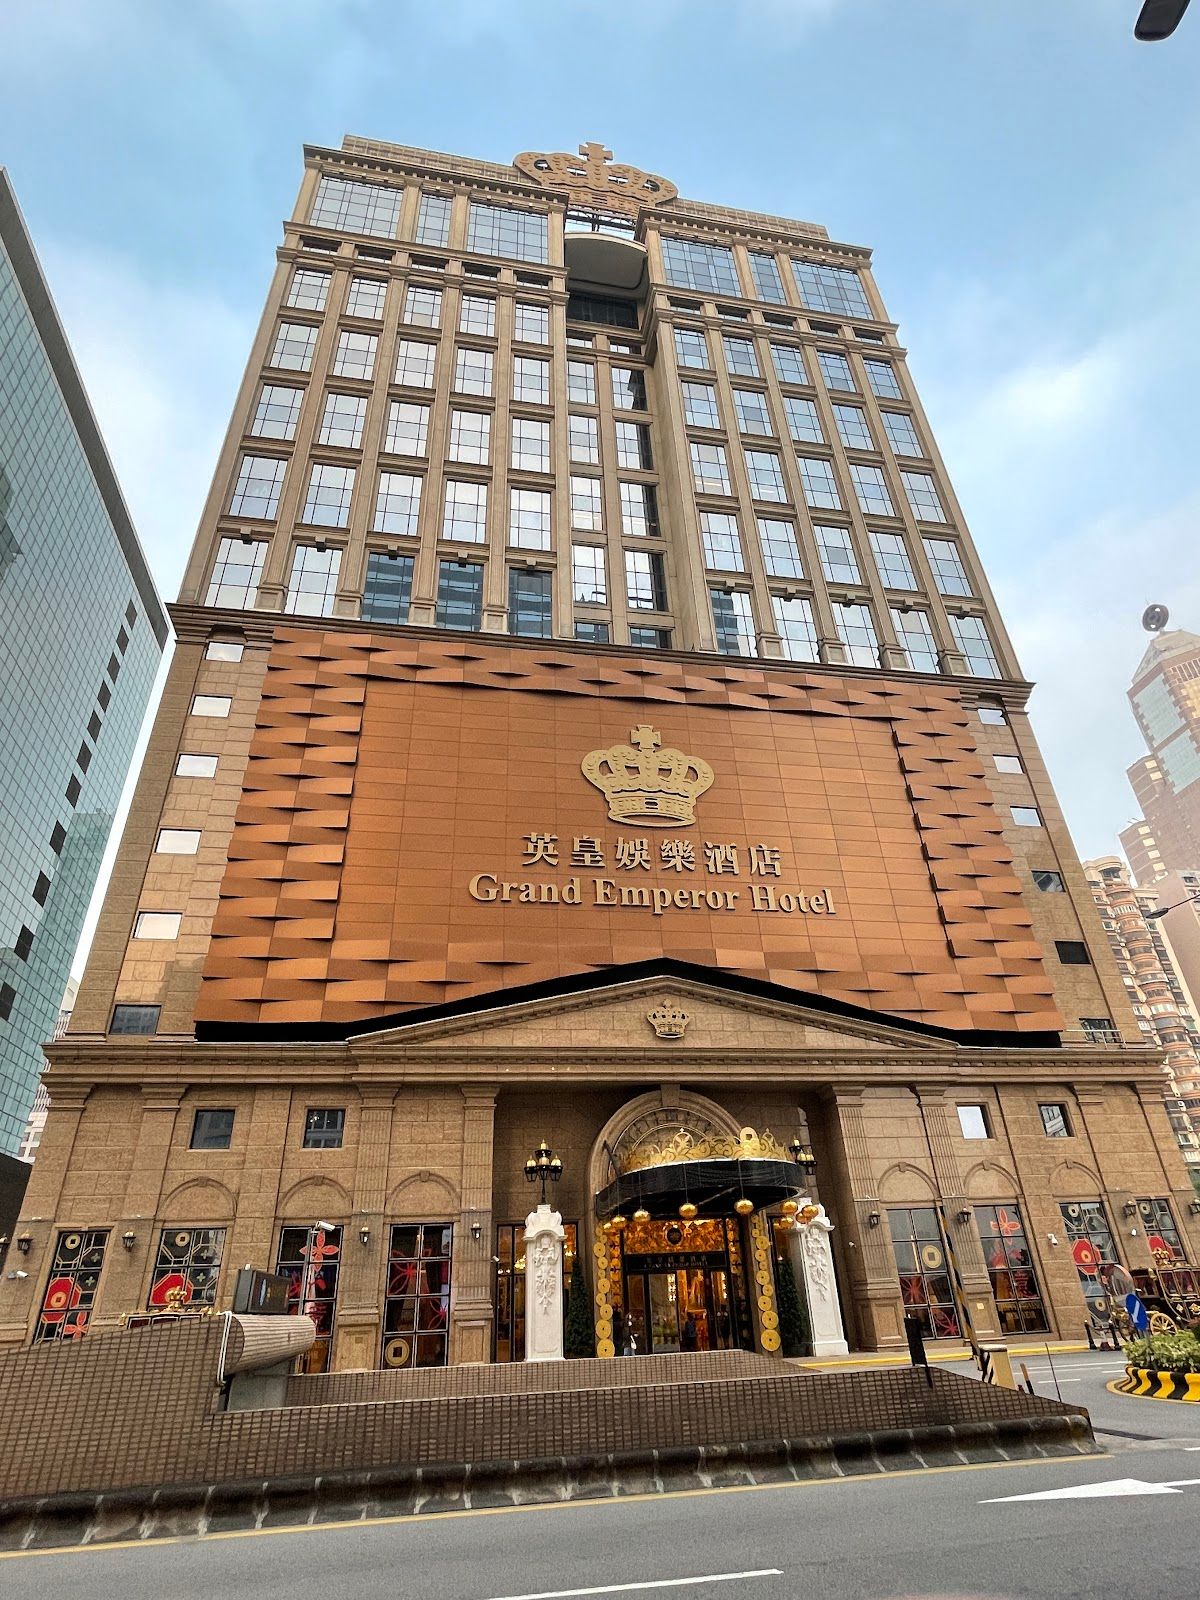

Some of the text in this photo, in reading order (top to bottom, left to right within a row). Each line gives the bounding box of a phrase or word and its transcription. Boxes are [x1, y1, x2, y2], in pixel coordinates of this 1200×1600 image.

[521, 832, 782, 877] 英皇娛樂酒店
[468, 873, 836, 915] Grand Emperor Hotel
